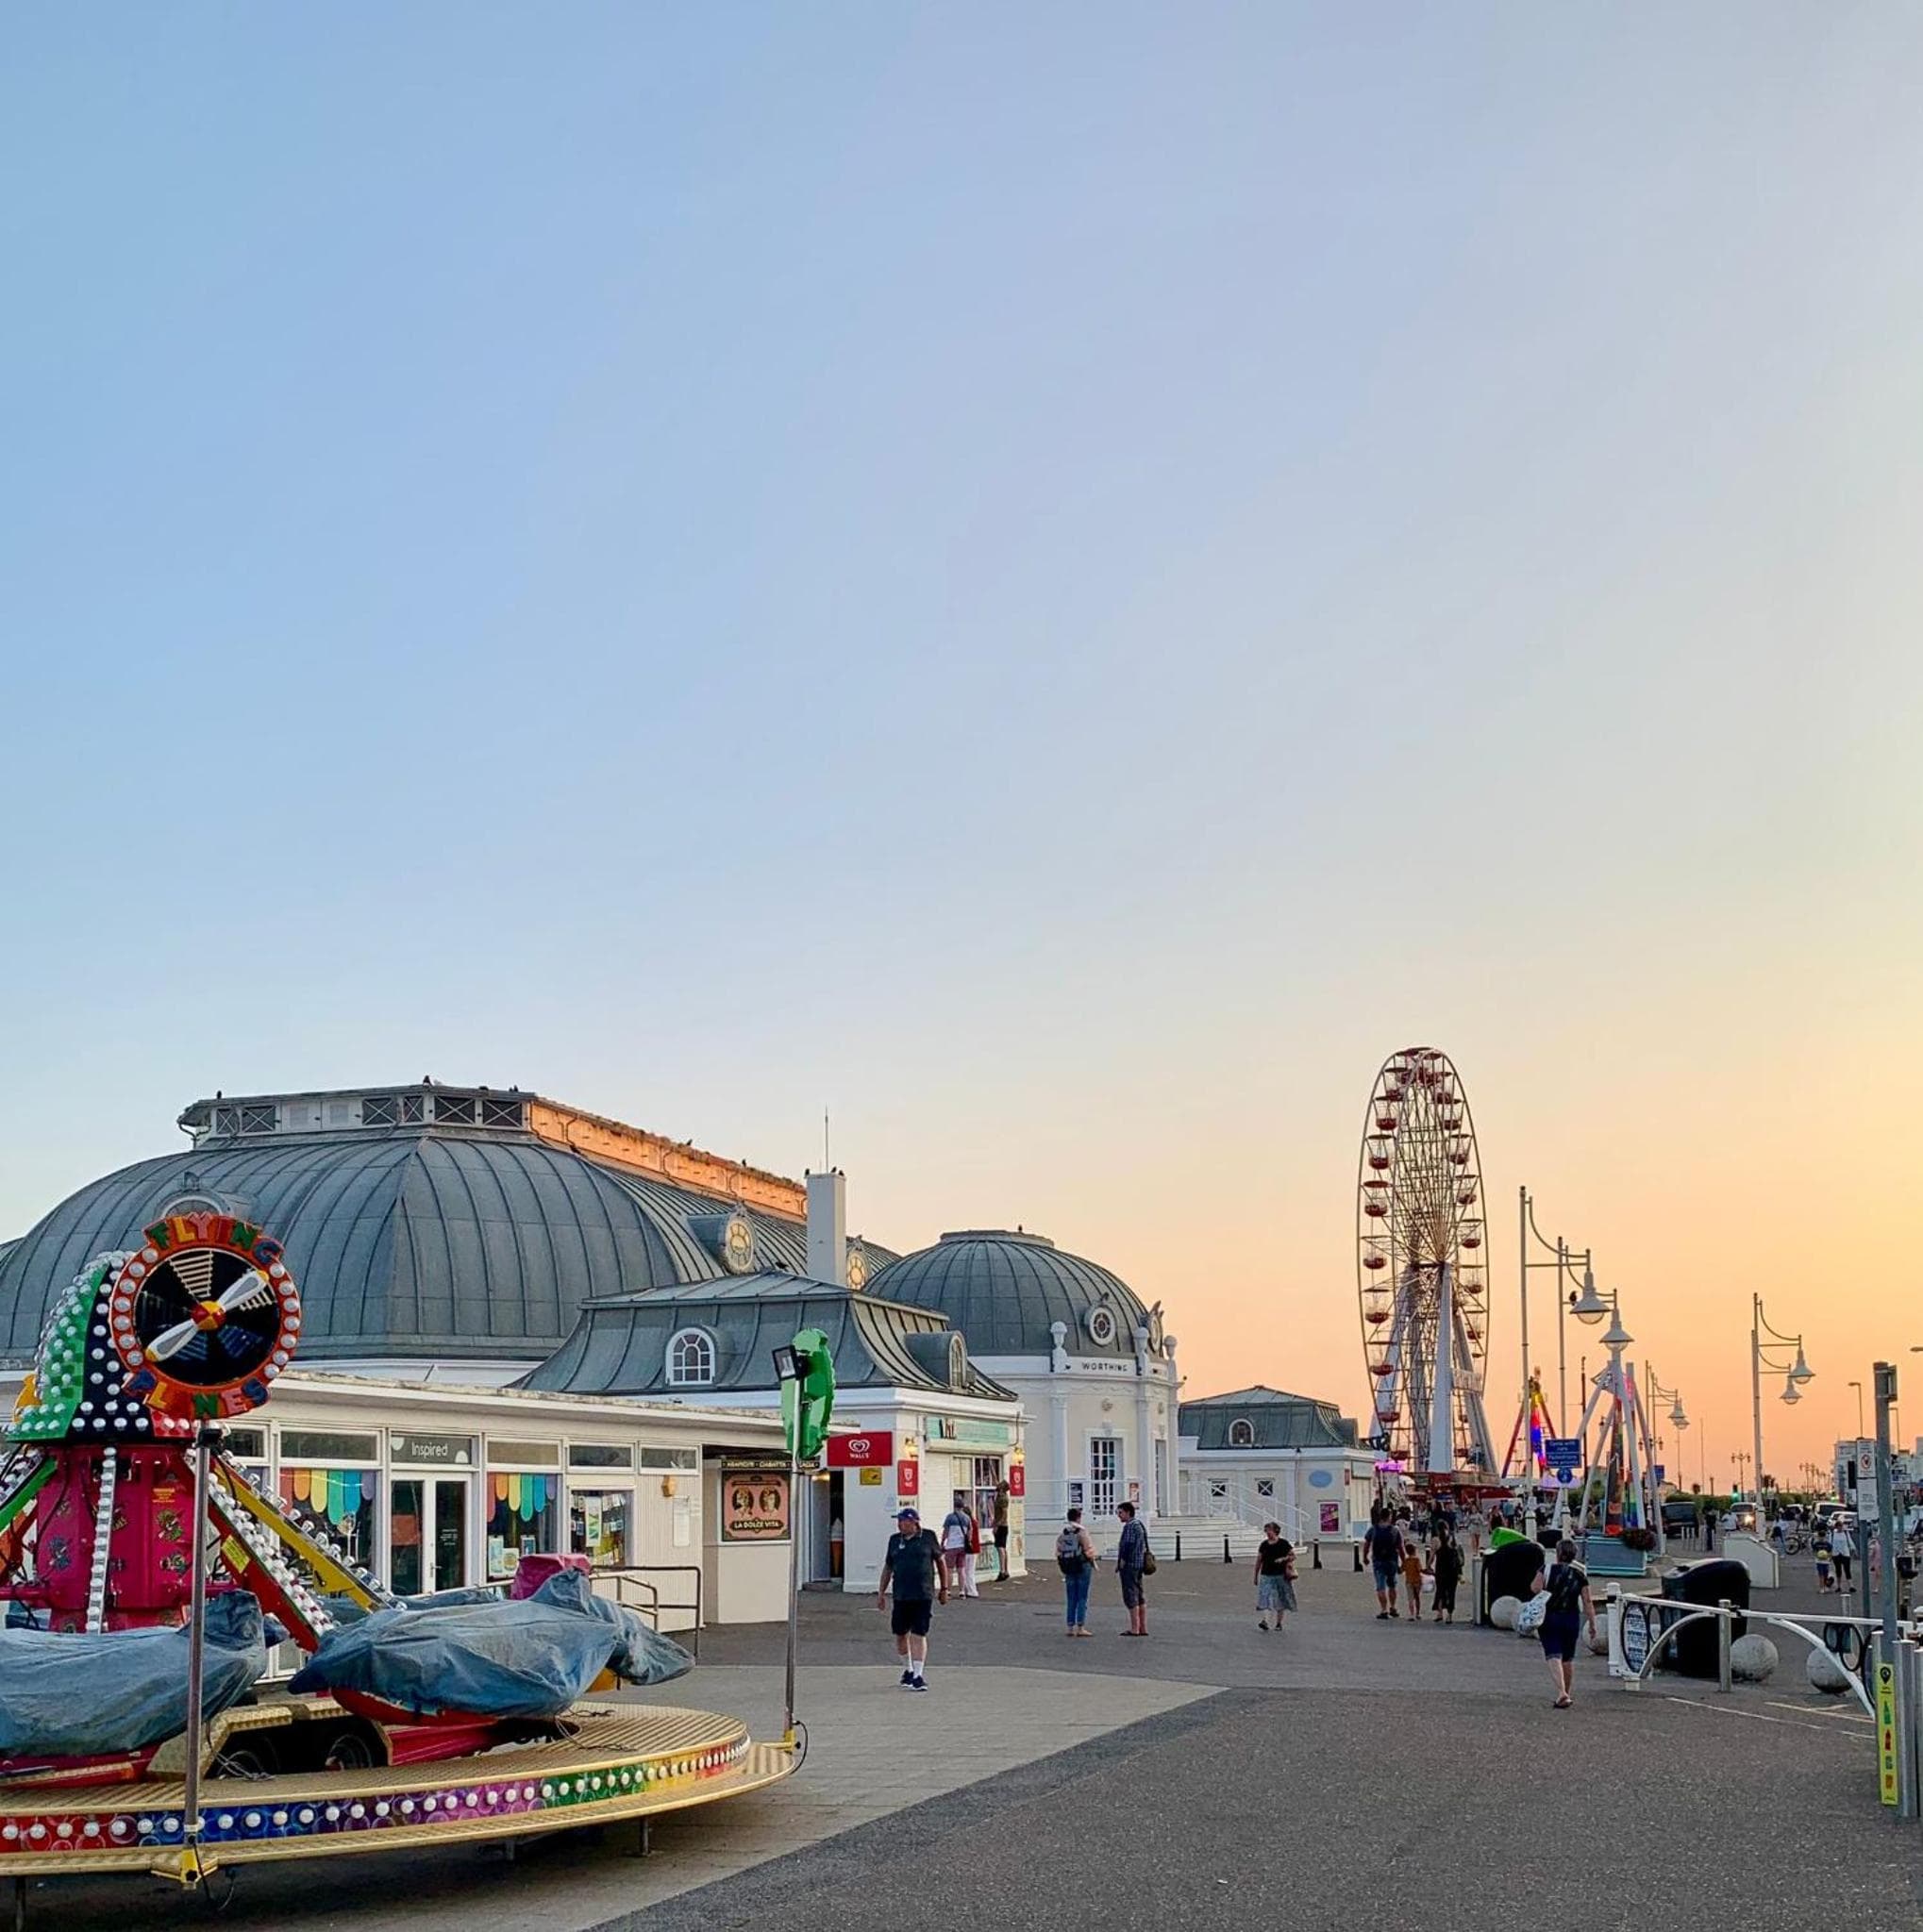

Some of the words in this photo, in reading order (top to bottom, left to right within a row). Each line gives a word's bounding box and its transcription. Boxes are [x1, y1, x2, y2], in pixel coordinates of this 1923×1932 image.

[147, 1211, 281, 1264] FLYING
[1081, 1361, 1129, 1373] WORTHING
[411, 1441, 448, 1459] Inspired
